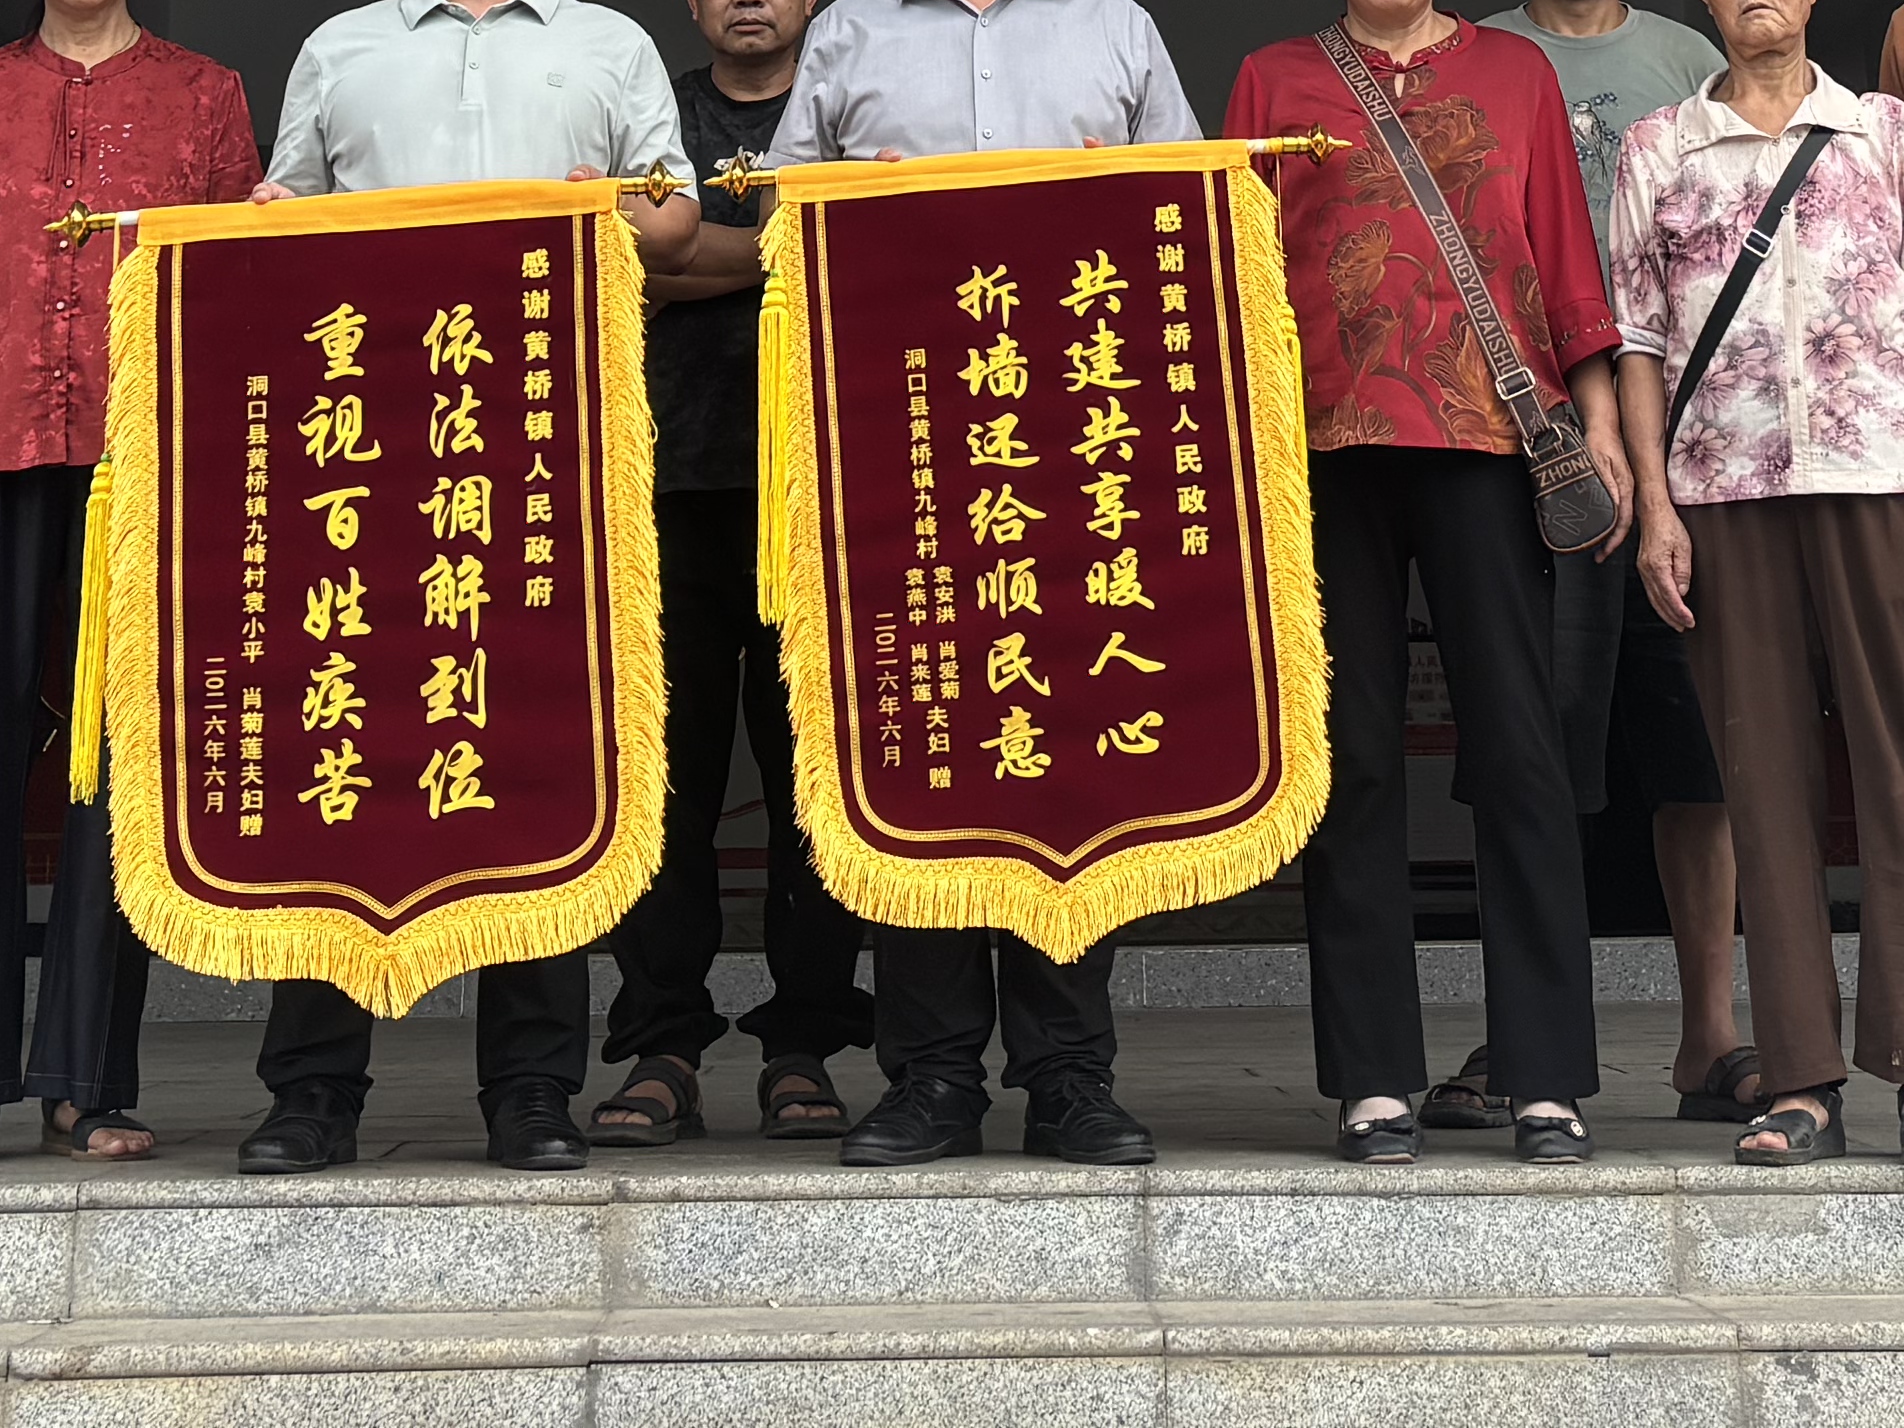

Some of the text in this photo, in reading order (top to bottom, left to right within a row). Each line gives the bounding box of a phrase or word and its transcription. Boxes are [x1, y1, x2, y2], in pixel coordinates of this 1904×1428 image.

[239, 375, 270, 837] 洞口县黄桥镇九峰村袁小平 肖菊莲夫妇赠
[297, 302, 382, 826] 重视百姓疾苦
[417, 303, 496, 821] 依法调解到位
[521, 247, 555, 609] 感谢黄桥镇人民政府
[904, 347, 939, 560] 洞口县黄桥镇九峰村
[956, 264, 1052, 781] 拆墙还给顺民意
[1059, 249, 1166, 758] 共建共享暖人心
[1154, 204, 1211, 557] 感谢黄桥镇人民政府
[926, 705, 952, 791] 夫妇 赠
